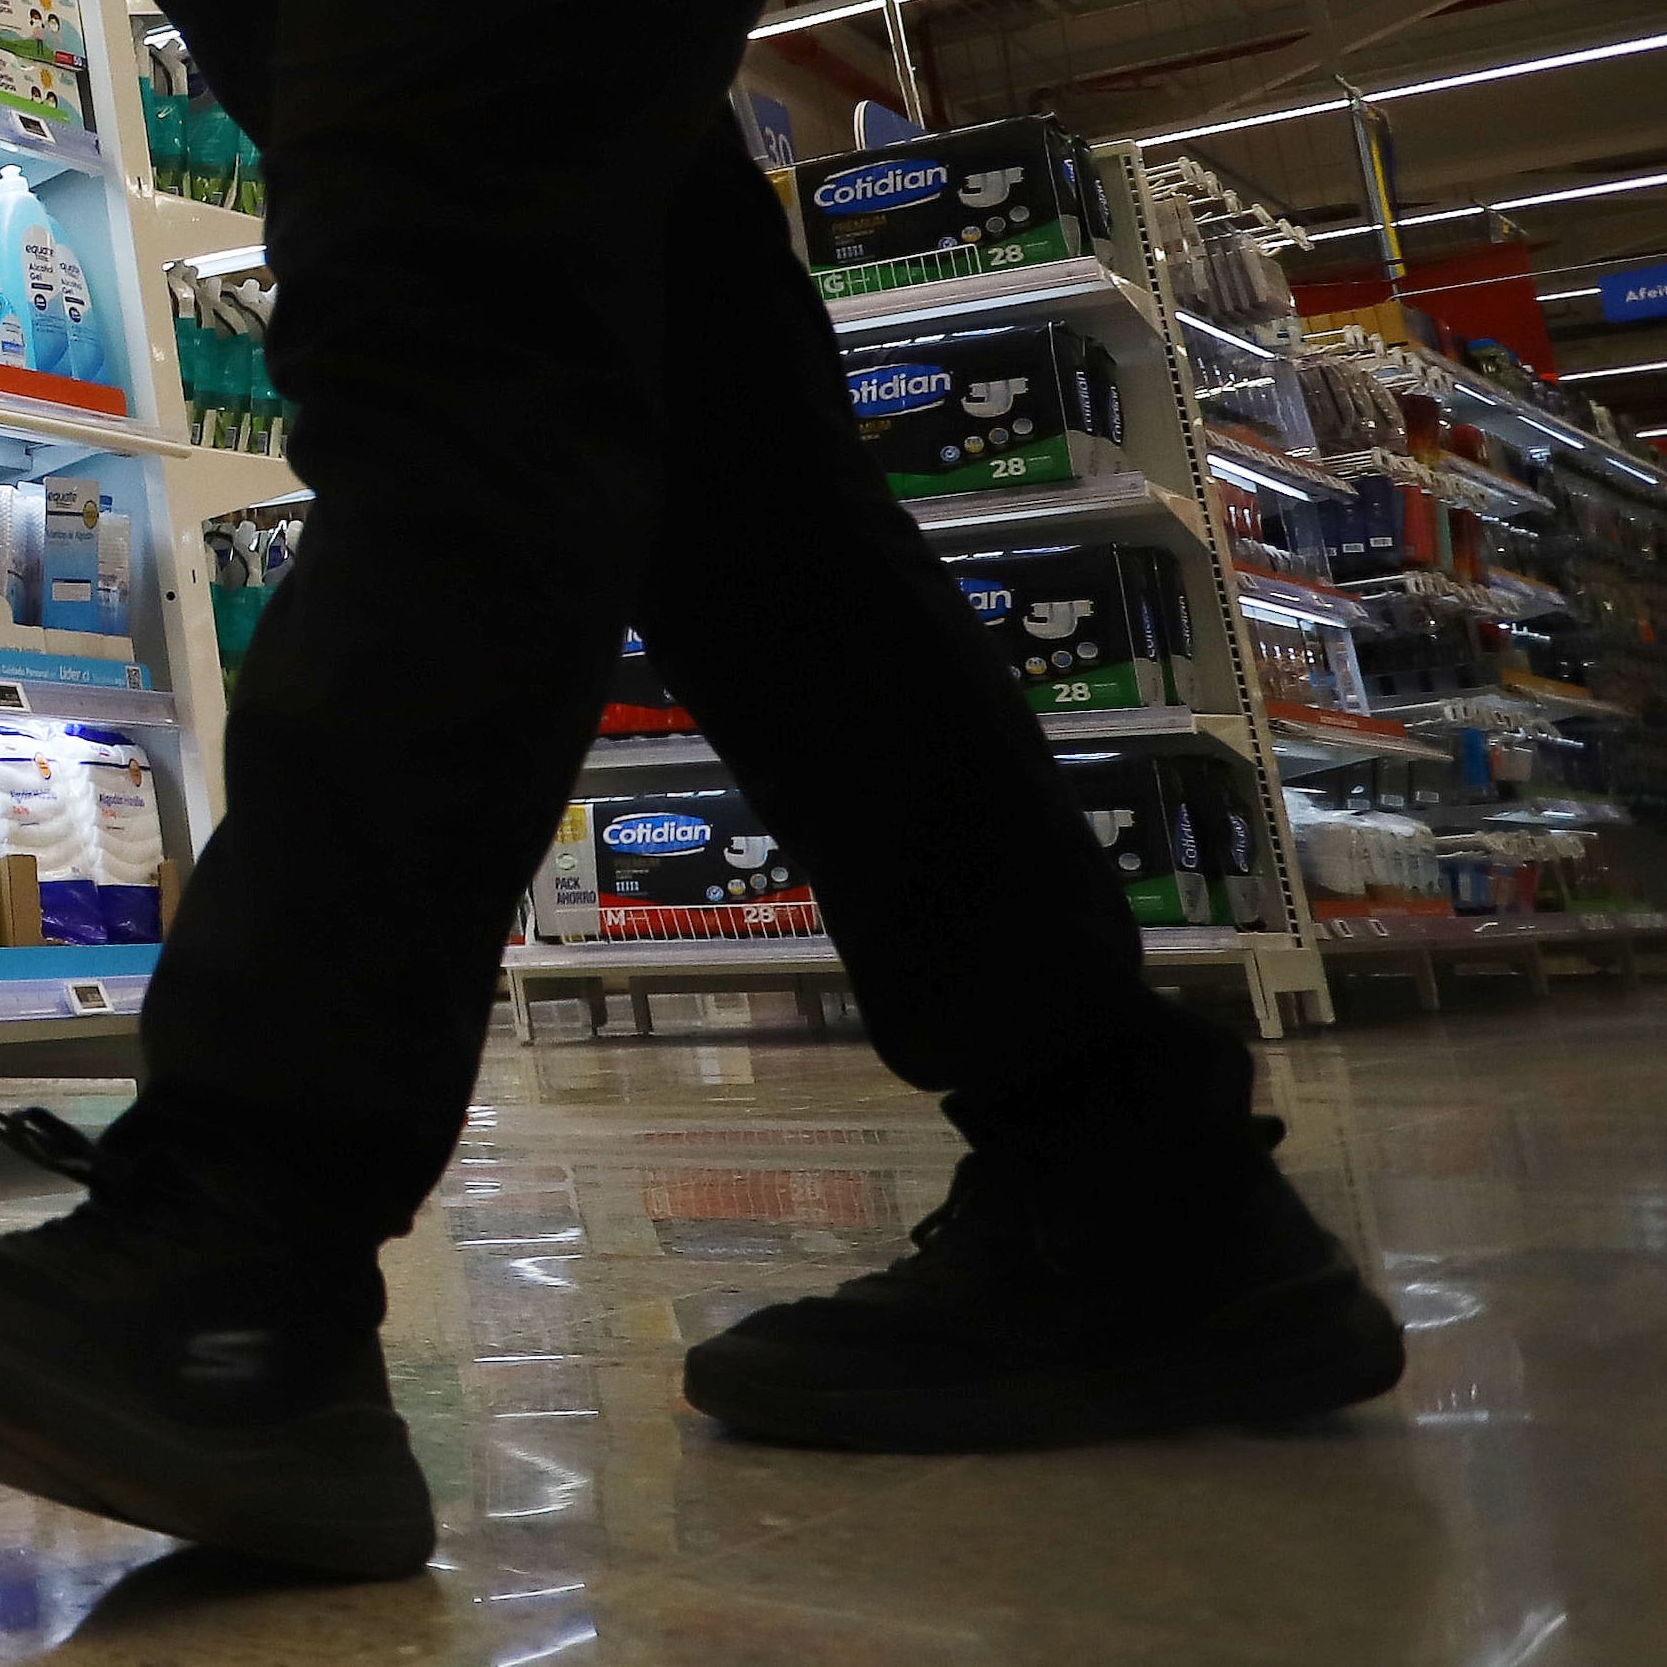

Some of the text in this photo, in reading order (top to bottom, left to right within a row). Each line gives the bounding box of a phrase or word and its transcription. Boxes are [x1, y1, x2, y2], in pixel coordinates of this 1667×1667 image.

[813, 163, 948, 207] Cotidian
[988, 244, 1024, 267] 28
[991, 458, 1026, 479] 28
[1054, 682, 1092, 704] 28
[602, 822, 712, 845] Cotidian
[555, 877, 580, 889] PACK
[557, 890, 596, 905] AHORRO
